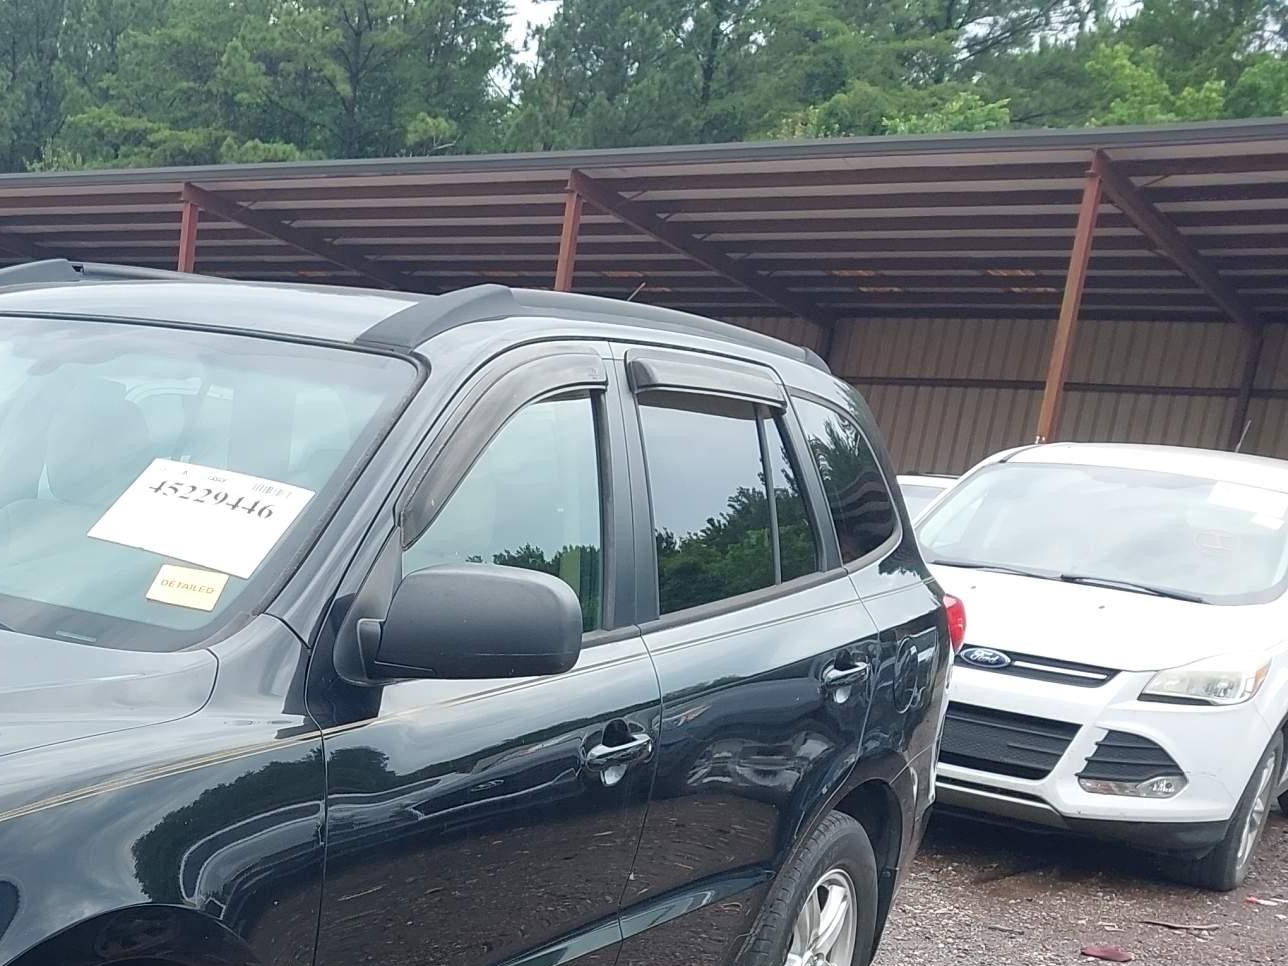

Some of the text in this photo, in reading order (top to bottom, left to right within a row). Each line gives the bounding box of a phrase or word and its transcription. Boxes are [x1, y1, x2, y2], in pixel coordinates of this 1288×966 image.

[148, 480, 274, 519] 45229446
[160, 578, 215, 595] DETAILED
[970, 649, 1000, 664] Ford
